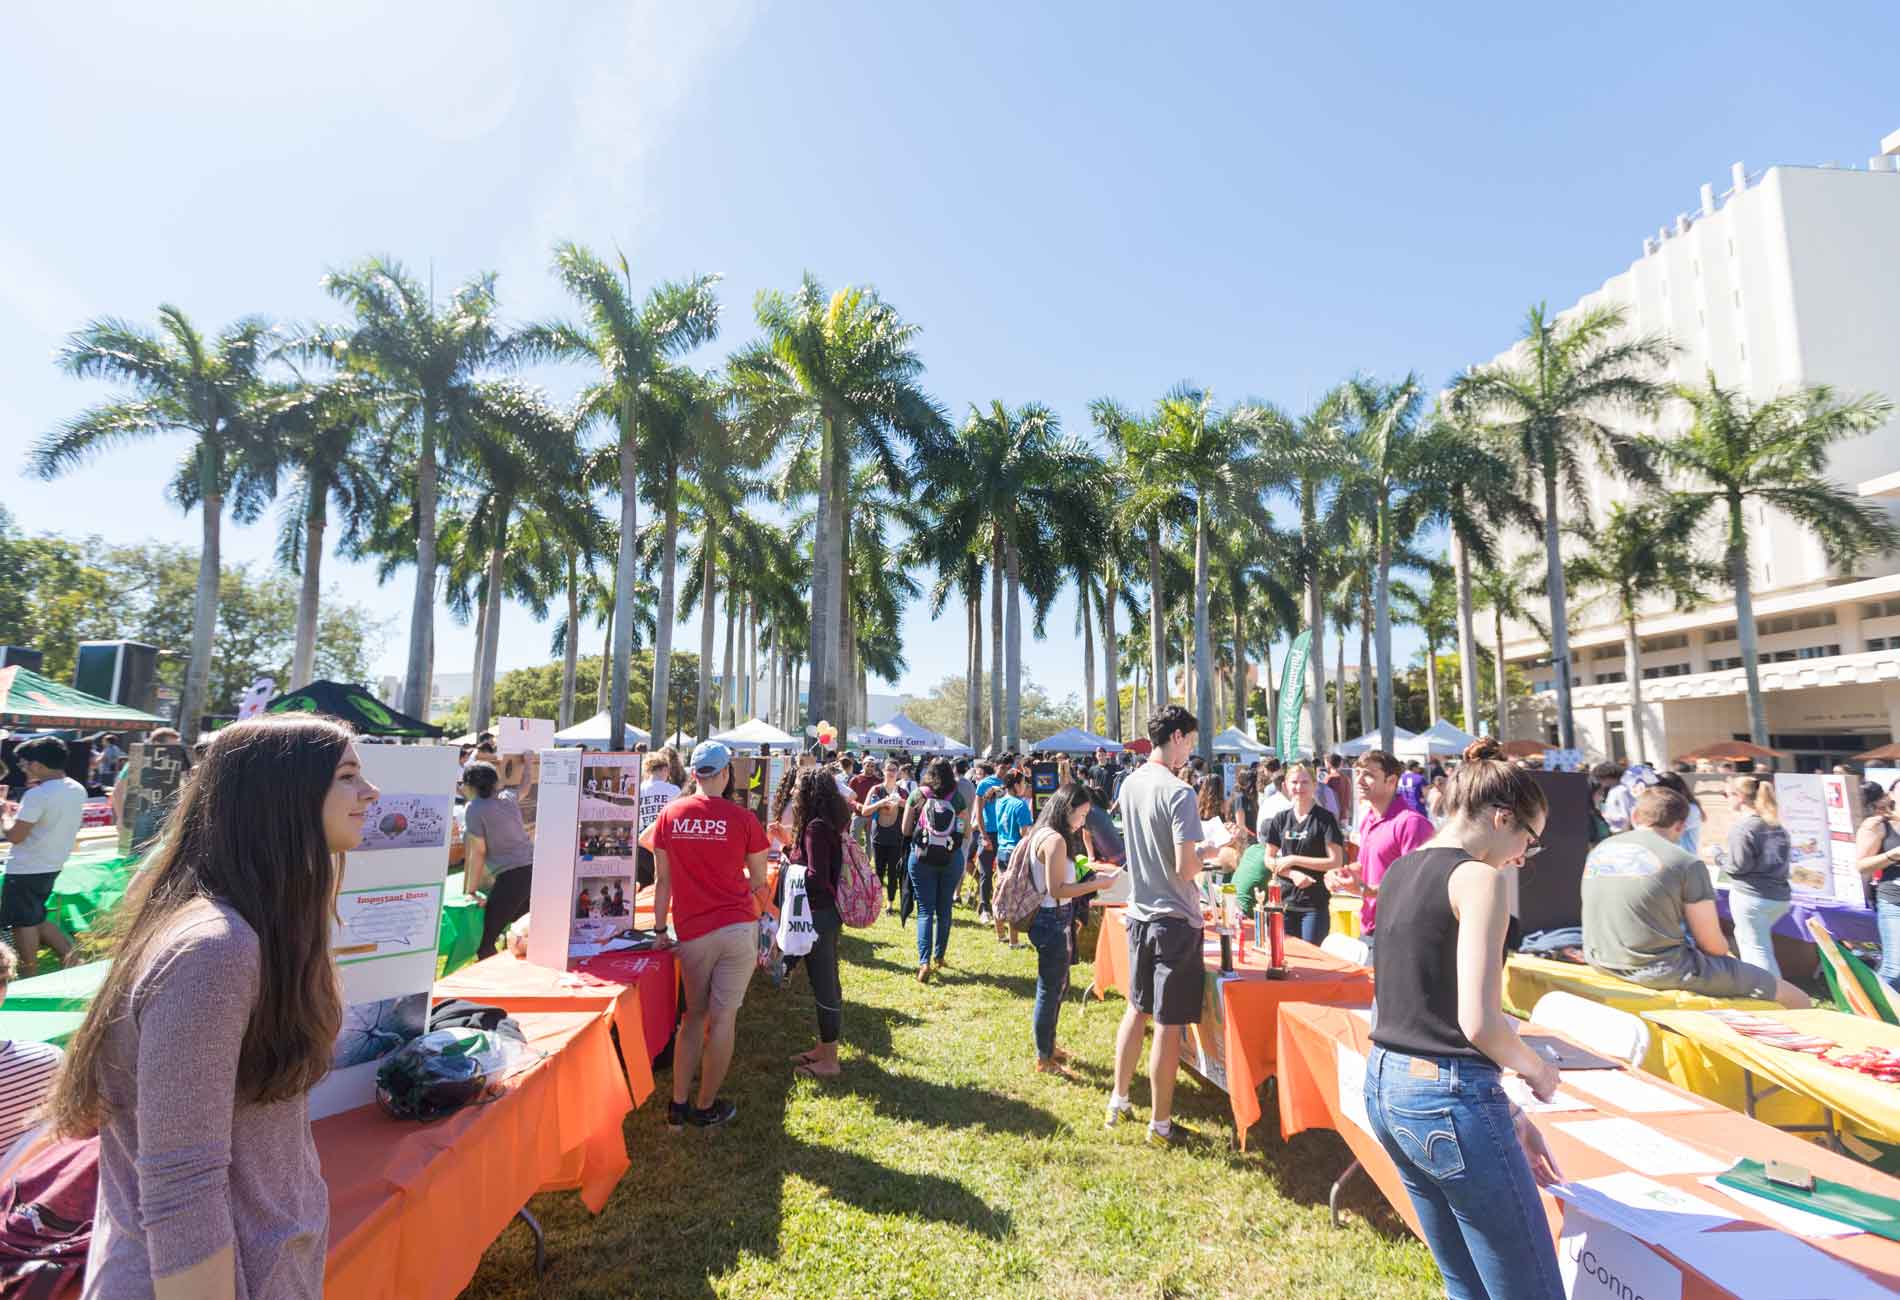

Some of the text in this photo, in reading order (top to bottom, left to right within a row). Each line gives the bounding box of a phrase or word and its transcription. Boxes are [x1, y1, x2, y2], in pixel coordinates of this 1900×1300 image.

[877, 735, 927, 746] Kettle Corn
[671, 818, 728, 835] MAPS
[356, 893, 403, 905] Important
